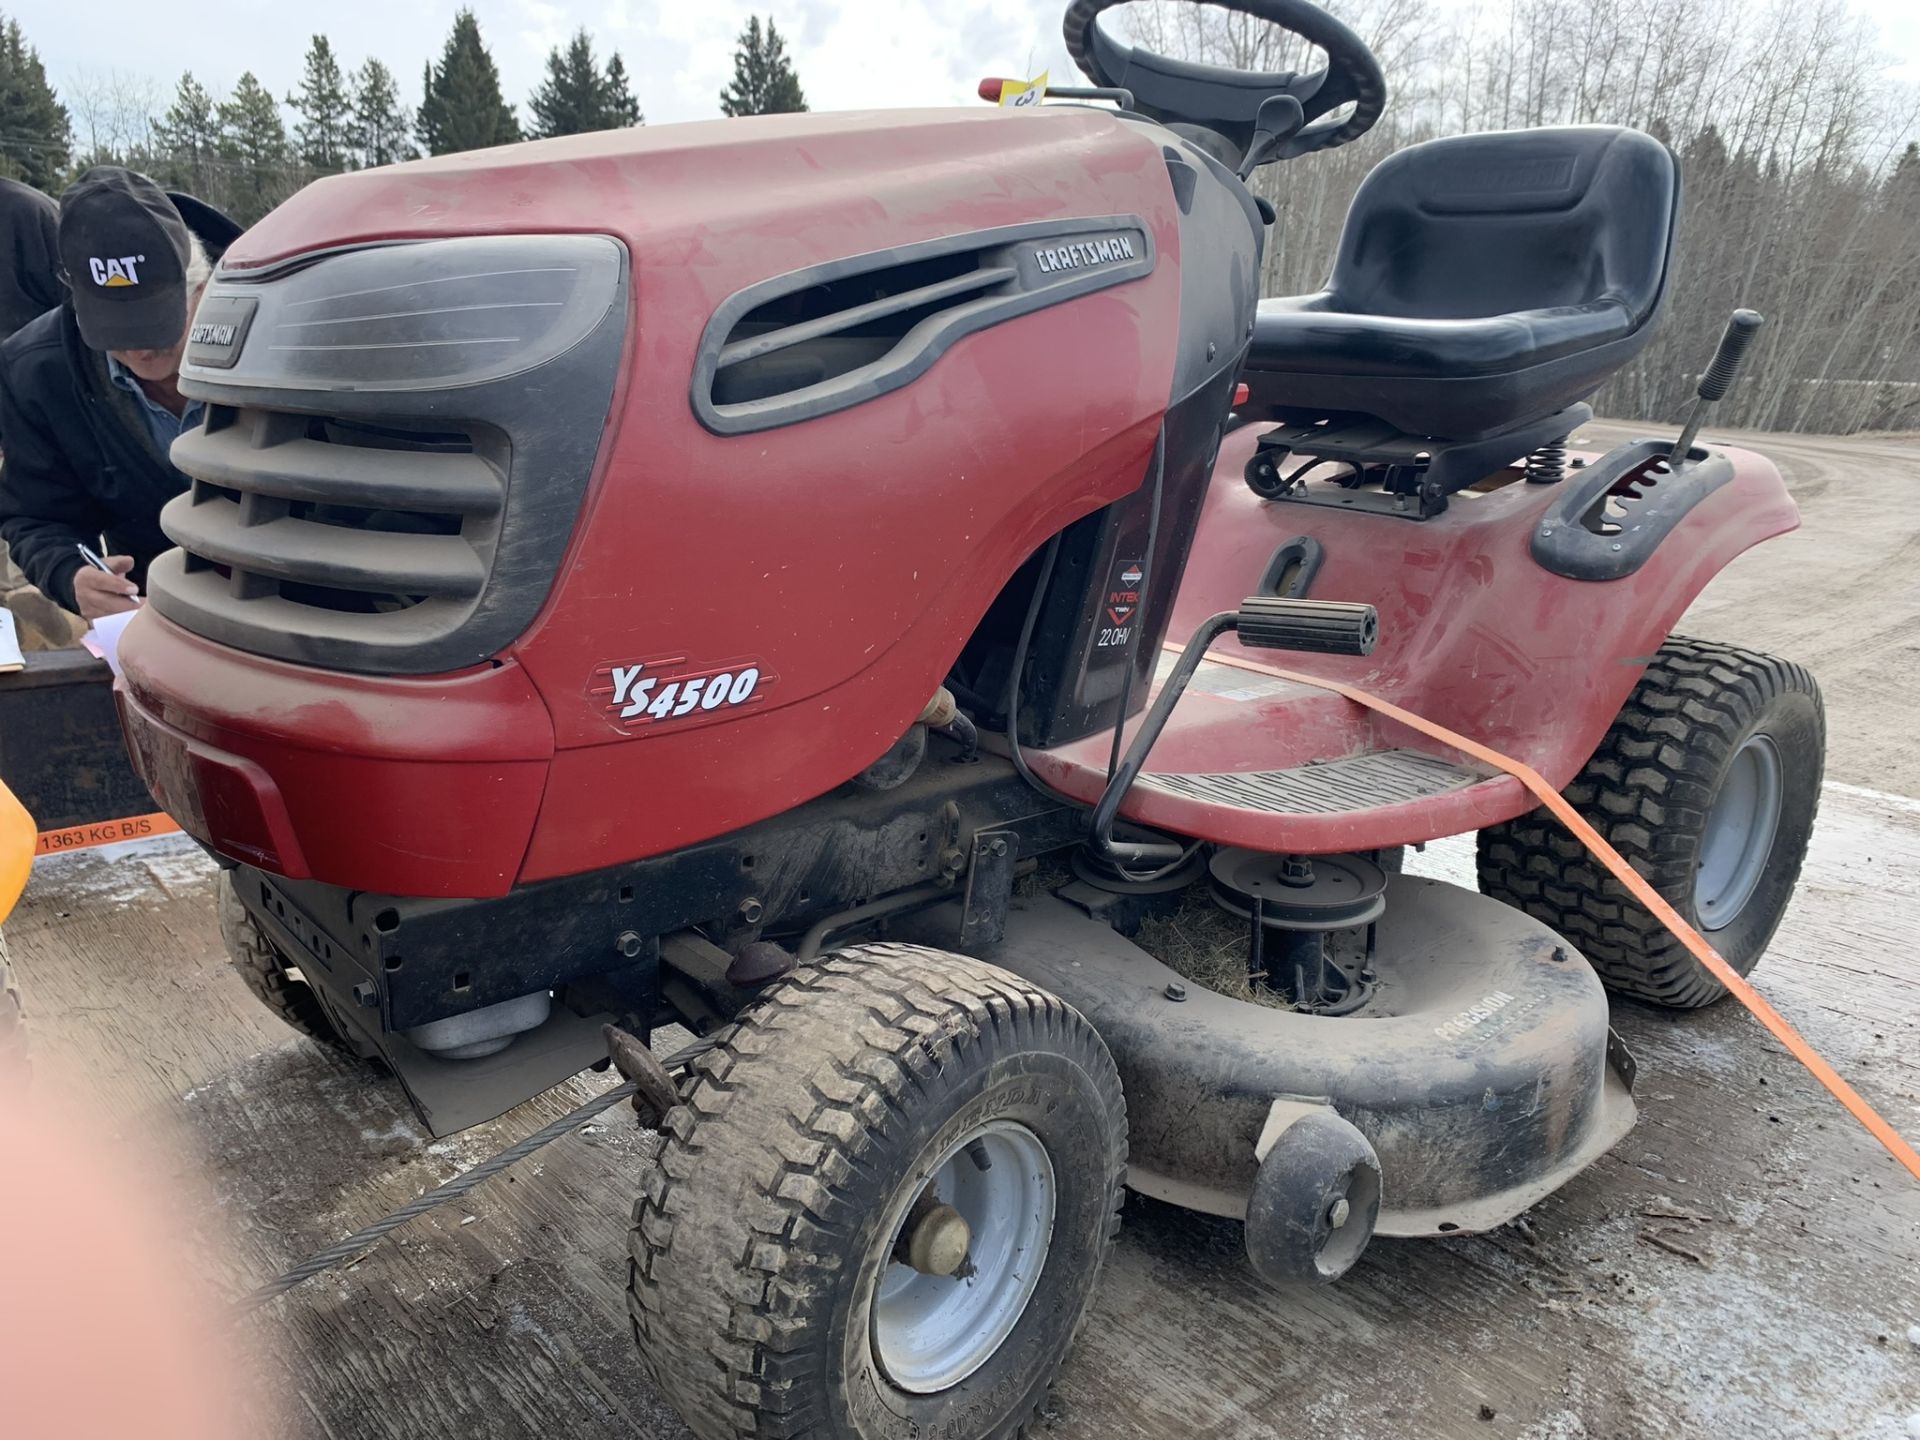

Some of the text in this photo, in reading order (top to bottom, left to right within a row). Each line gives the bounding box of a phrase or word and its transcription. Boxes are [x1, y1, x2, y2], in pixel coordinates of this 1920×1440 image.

[89, 255, 140, 287] CAT
[1035, 237, 1134, 273] CRAFTSMAN
[1109, 592, 1142, 602] INTEK
[1098, 627, 1132, 646] 22 OHV
[611, 664, 760, 719] YS4500
[41, 820, 152, 850] 1363 KG B/S
[1434, 990, 1515, 1041] PRECISION
[940, 1087, 1042, 1152] KENDA
